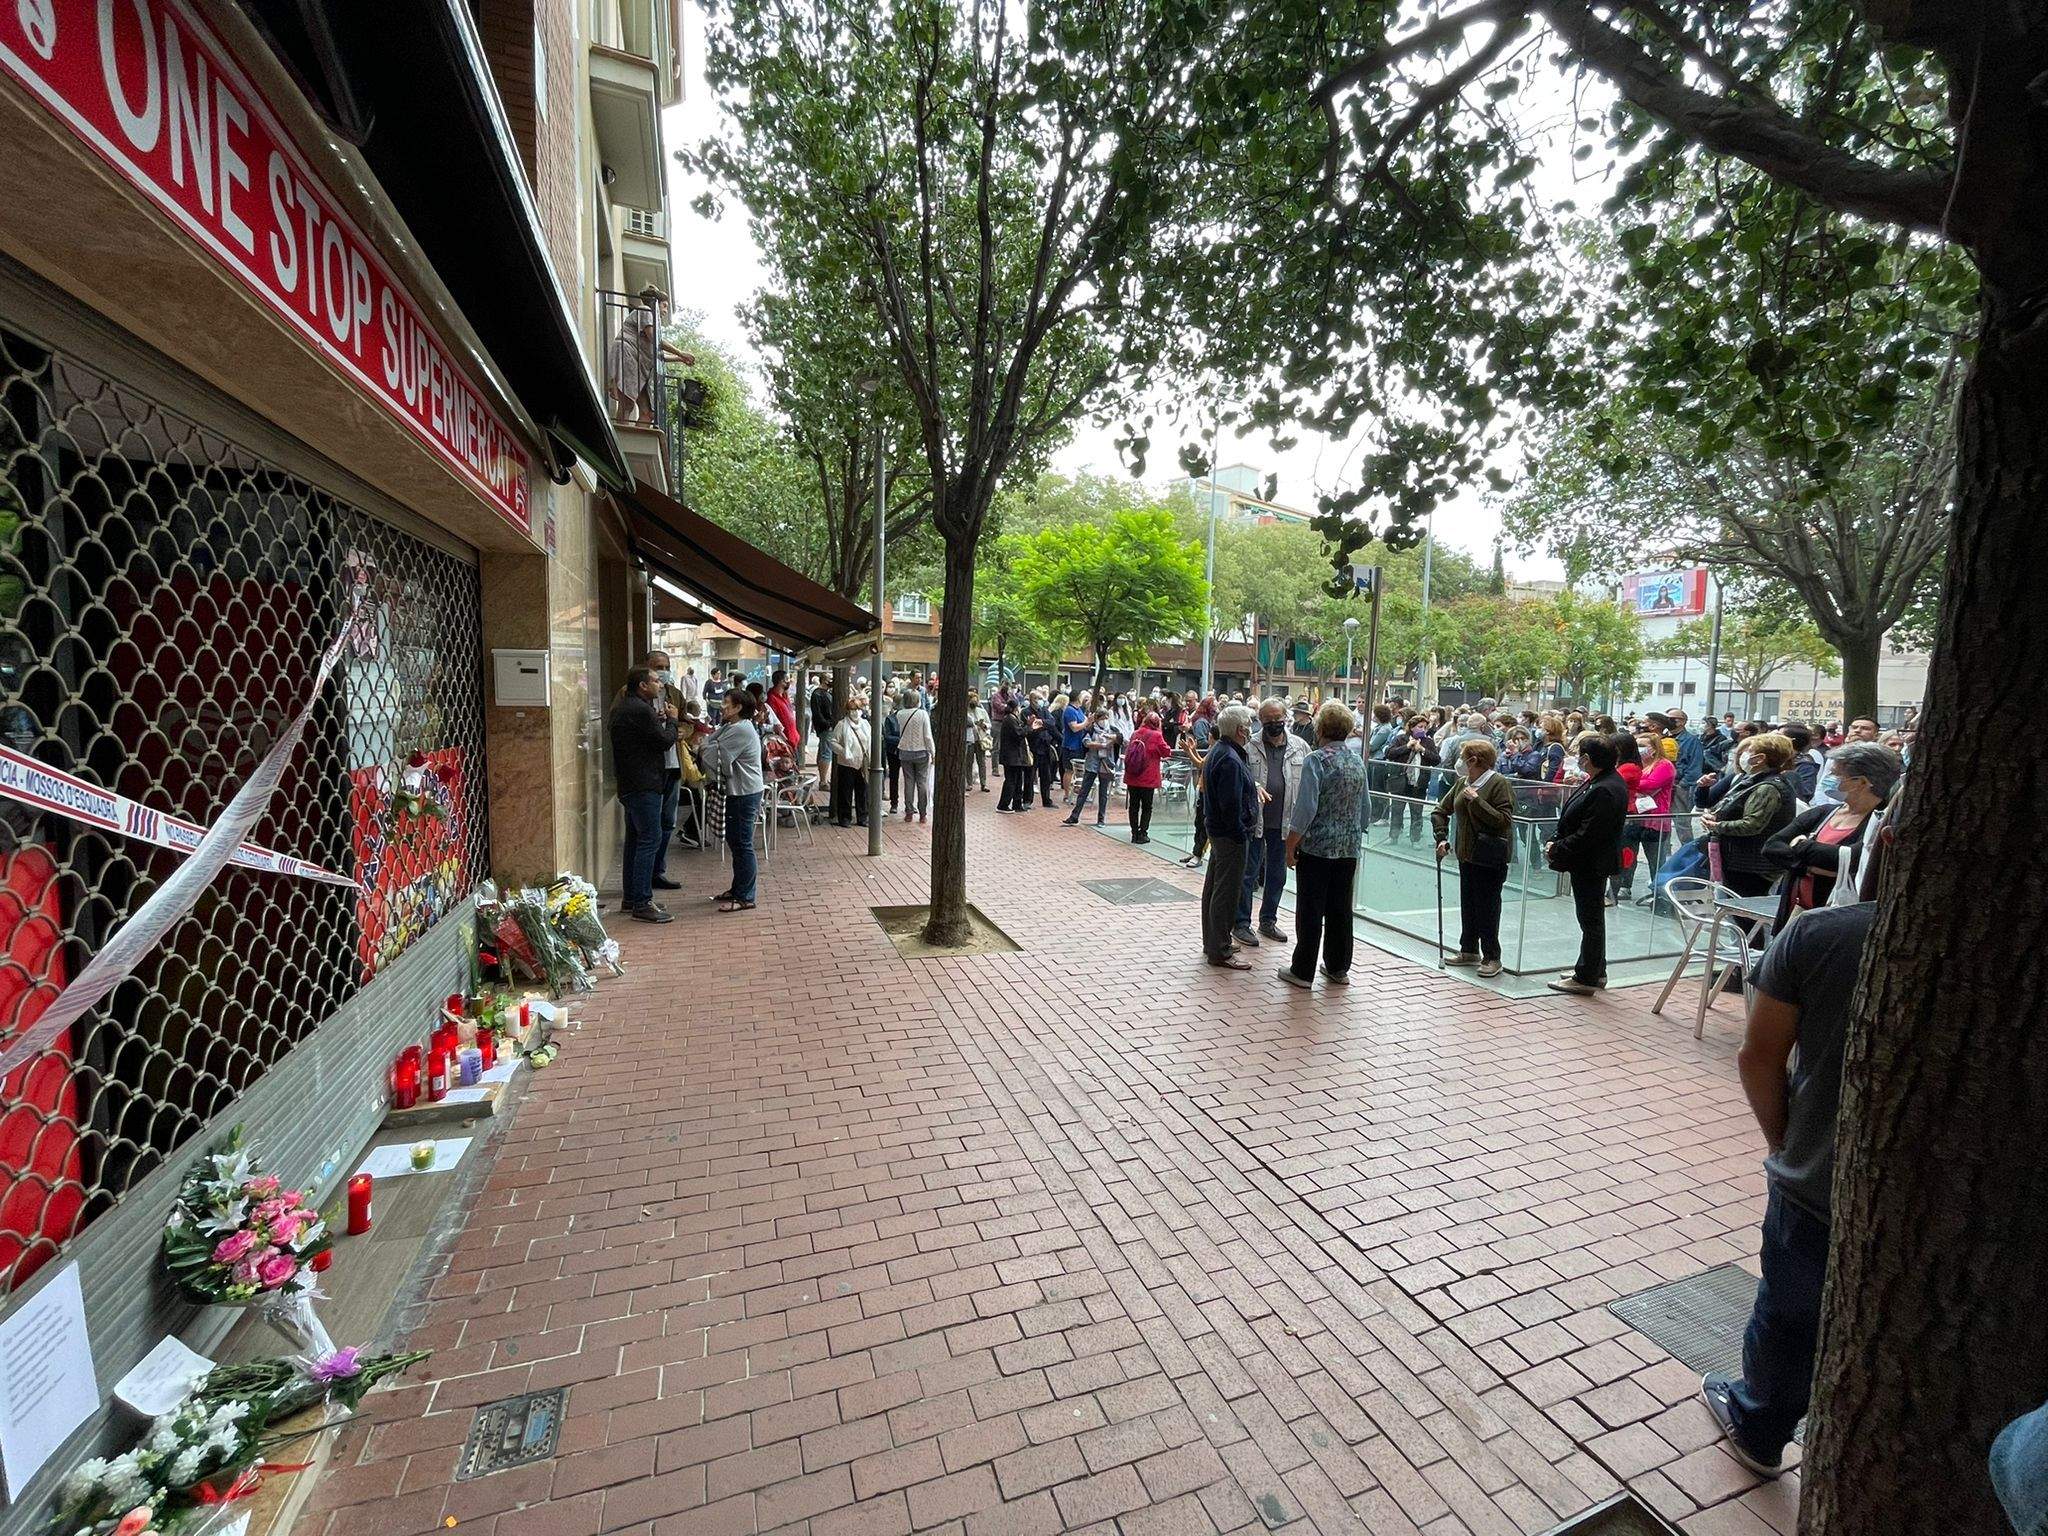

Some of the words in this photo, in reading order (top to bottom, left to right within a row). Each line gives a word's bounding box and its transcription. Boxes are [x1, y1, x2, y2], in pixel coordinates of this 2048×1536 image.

[97, 0, 254, 256] ONE
[268, 150, 372, 357] STOP
[381, 286, 512, 499] SUPERMERCAT
[1788, 709, 1799, 717] DE
[1825, 709, 1838, 718] DE
[1789, 700, 1823, 708] ESCOLA
[1828, 700, 1844, 708] MA
[0, 759, 17, 786] CIA
[26, 770, 66, 801] MOSSOS
[66, 785, 119, 823] D'ESQUADRA
